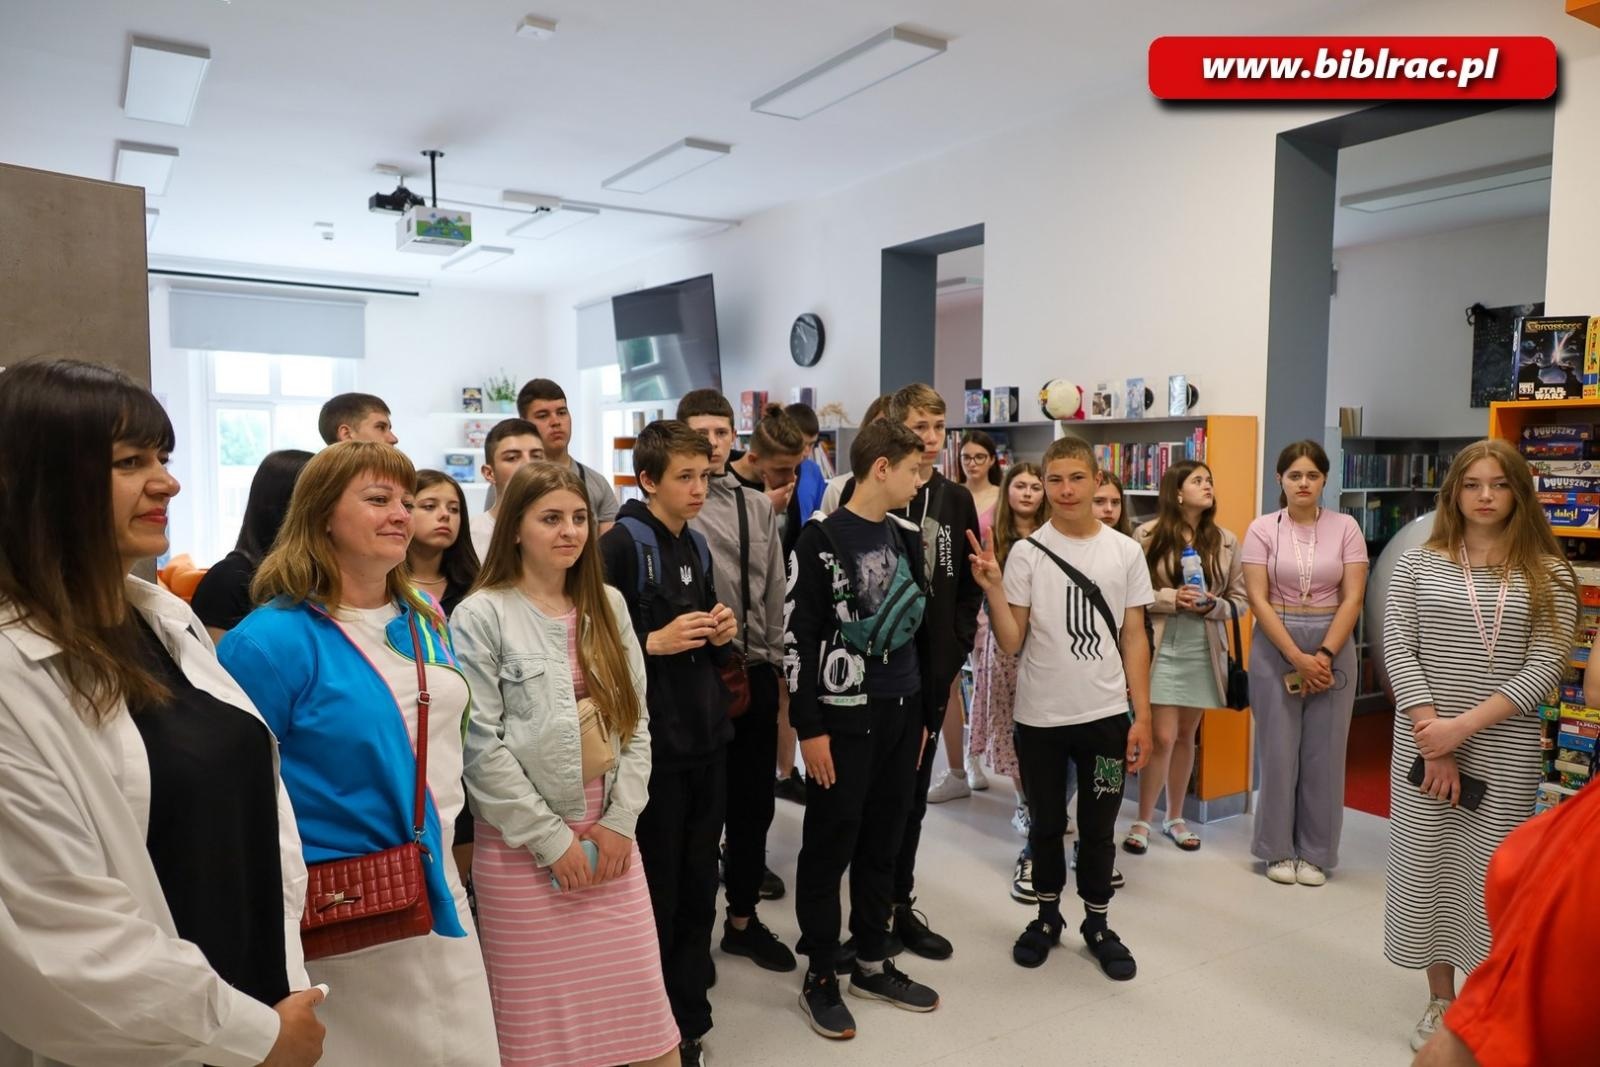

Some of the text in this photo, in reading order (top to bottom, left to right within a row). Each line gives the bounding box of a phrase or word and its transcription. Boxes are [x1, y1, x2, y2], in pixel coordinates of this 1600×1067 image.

[1535, 390, 1566, 400] WARS
[1538, 386, 1566, 394] STAR
[938, 525, 946, 566] ARMANI
[945, 525, 954, 577] EXCHANGE
